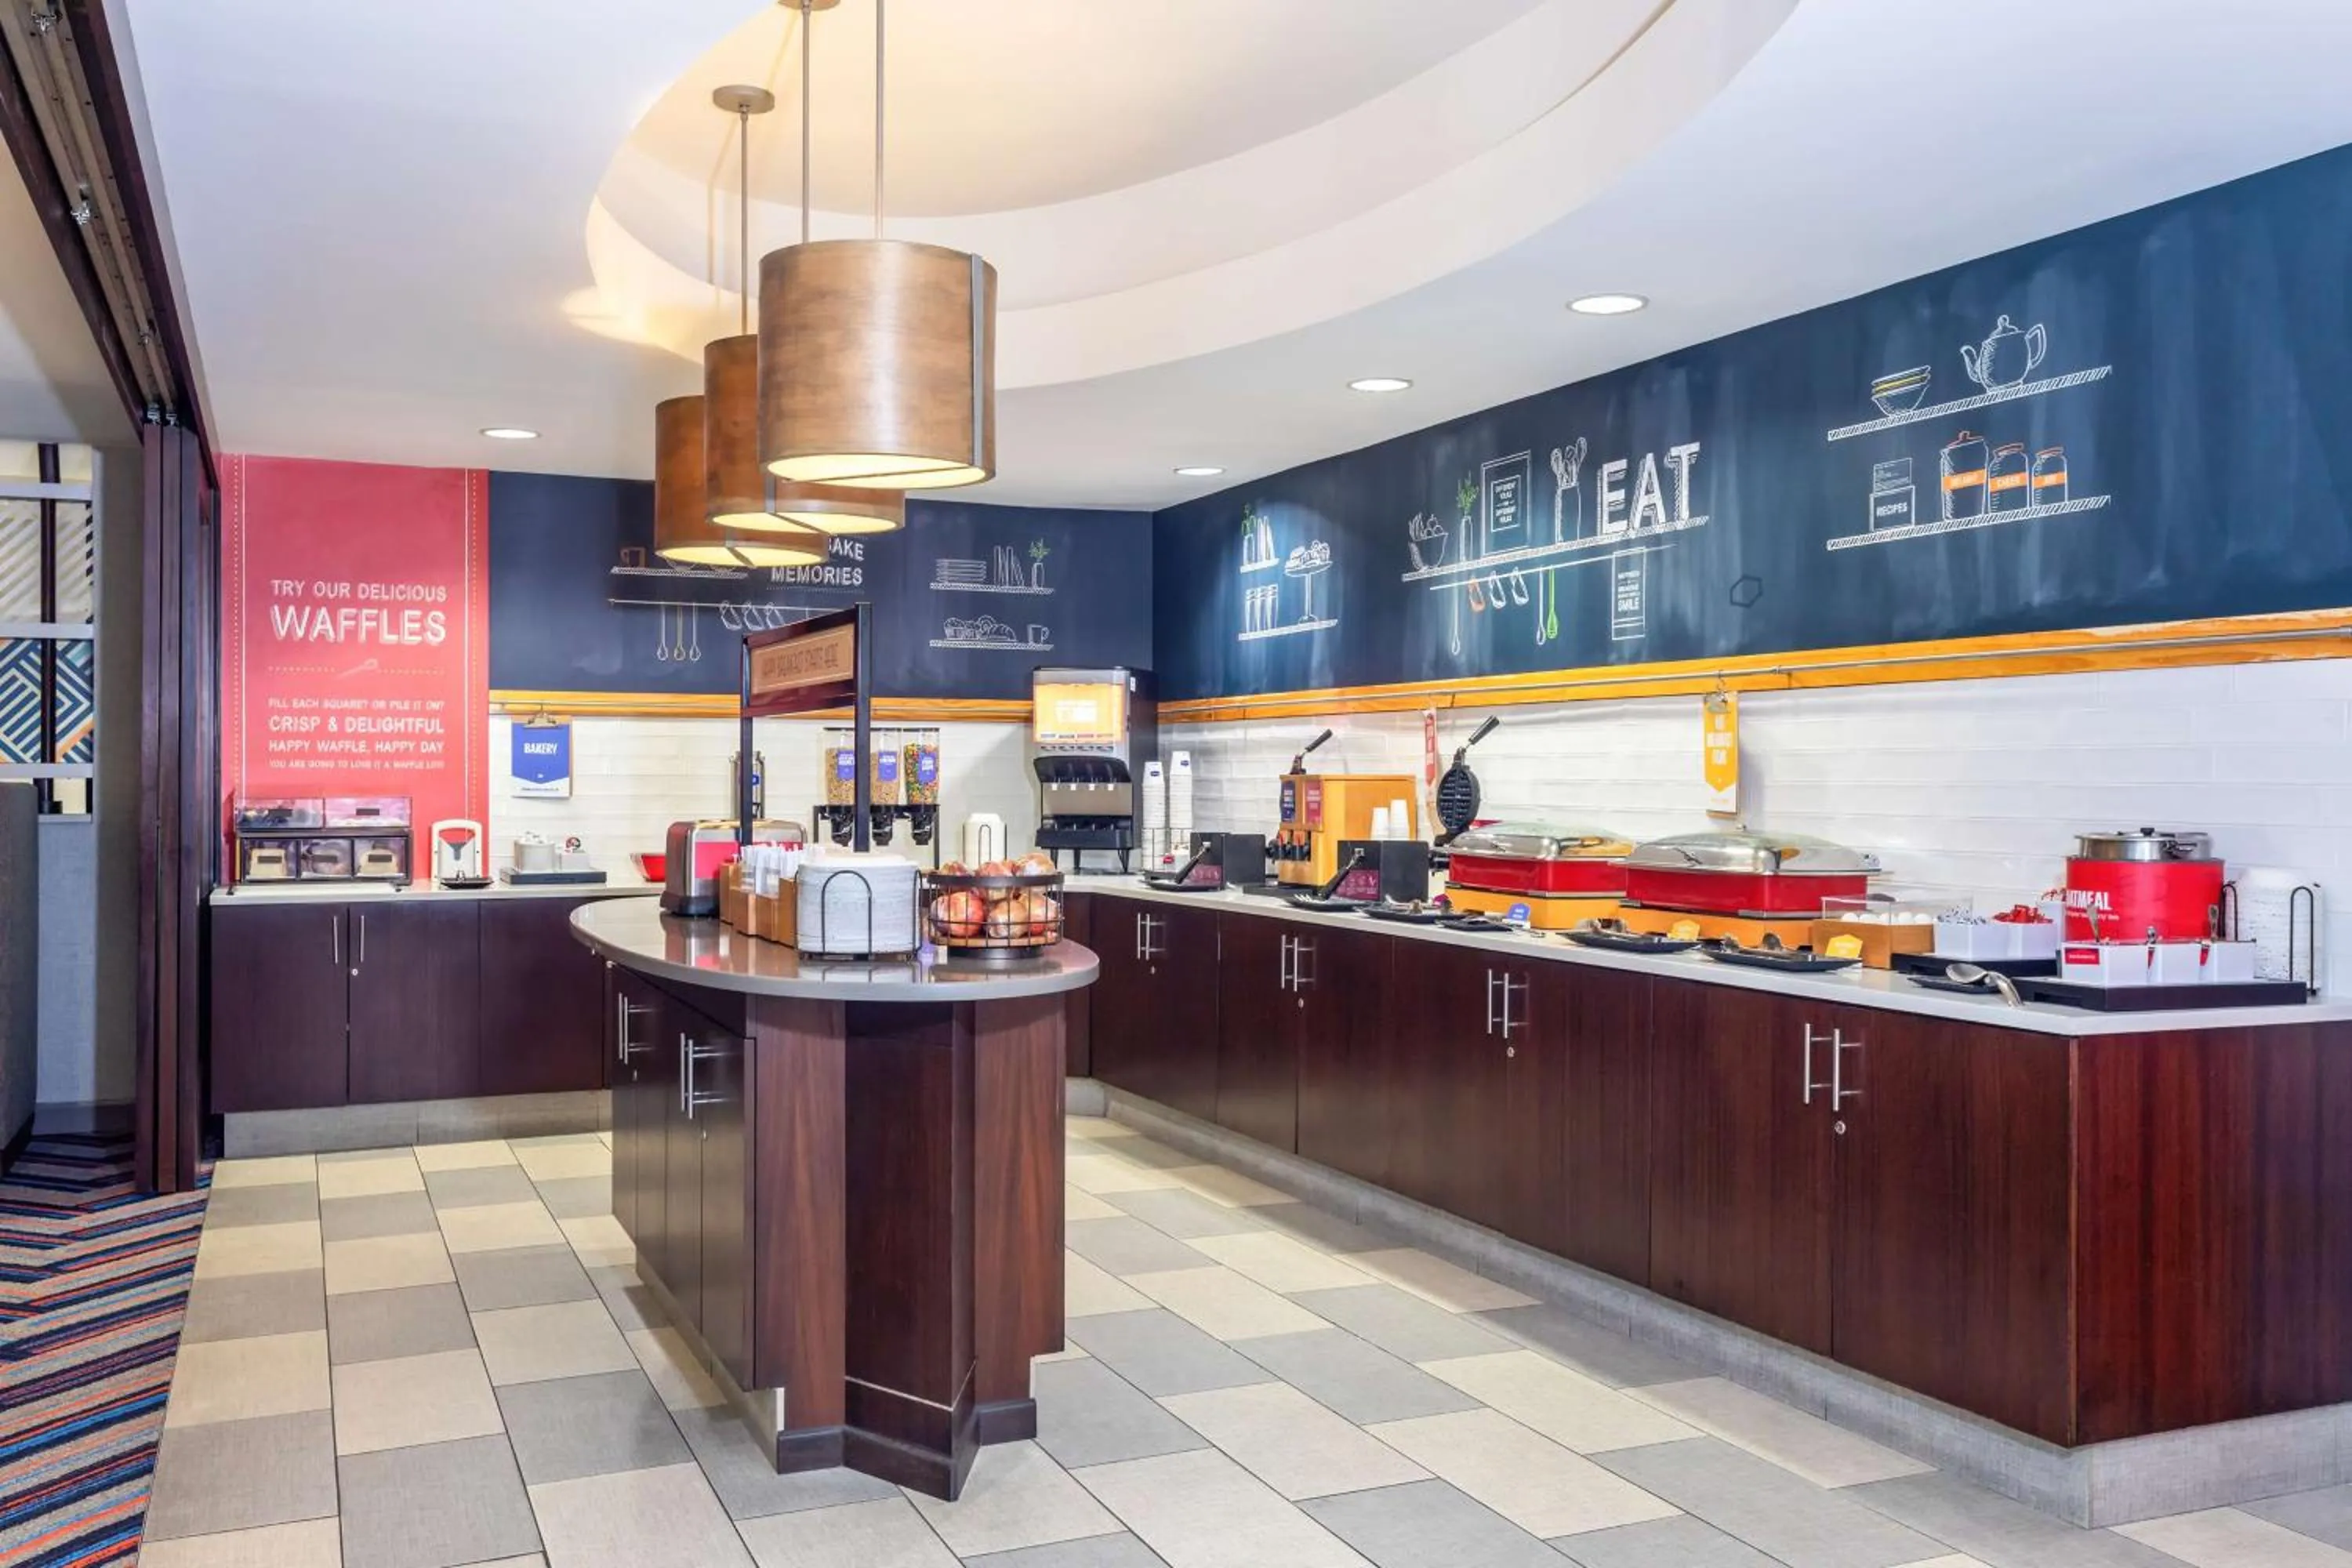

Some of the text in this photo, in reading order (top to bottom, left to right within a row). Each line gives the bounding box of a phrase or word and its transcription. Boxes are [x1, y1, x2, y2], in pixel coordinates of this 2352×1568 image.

[1597, 441, 1700, 535] EAT
[827, 537, 865, 562] AKE
[770, 565, 863, 587] MEMORIES
[270, 579, 447, 602] TRY OUR DELICIOUS
[270, 604, 447, 645] WAFFLES
[268, 715, 445, 735] CRISP & DELIGHTFUL
[268, 739, 311, 753] HAPPY
[375, 739, 417, 753] HAPPY
[419, 740, 445, 754] DAY
[523, 742, 558, 755] BAKERY
